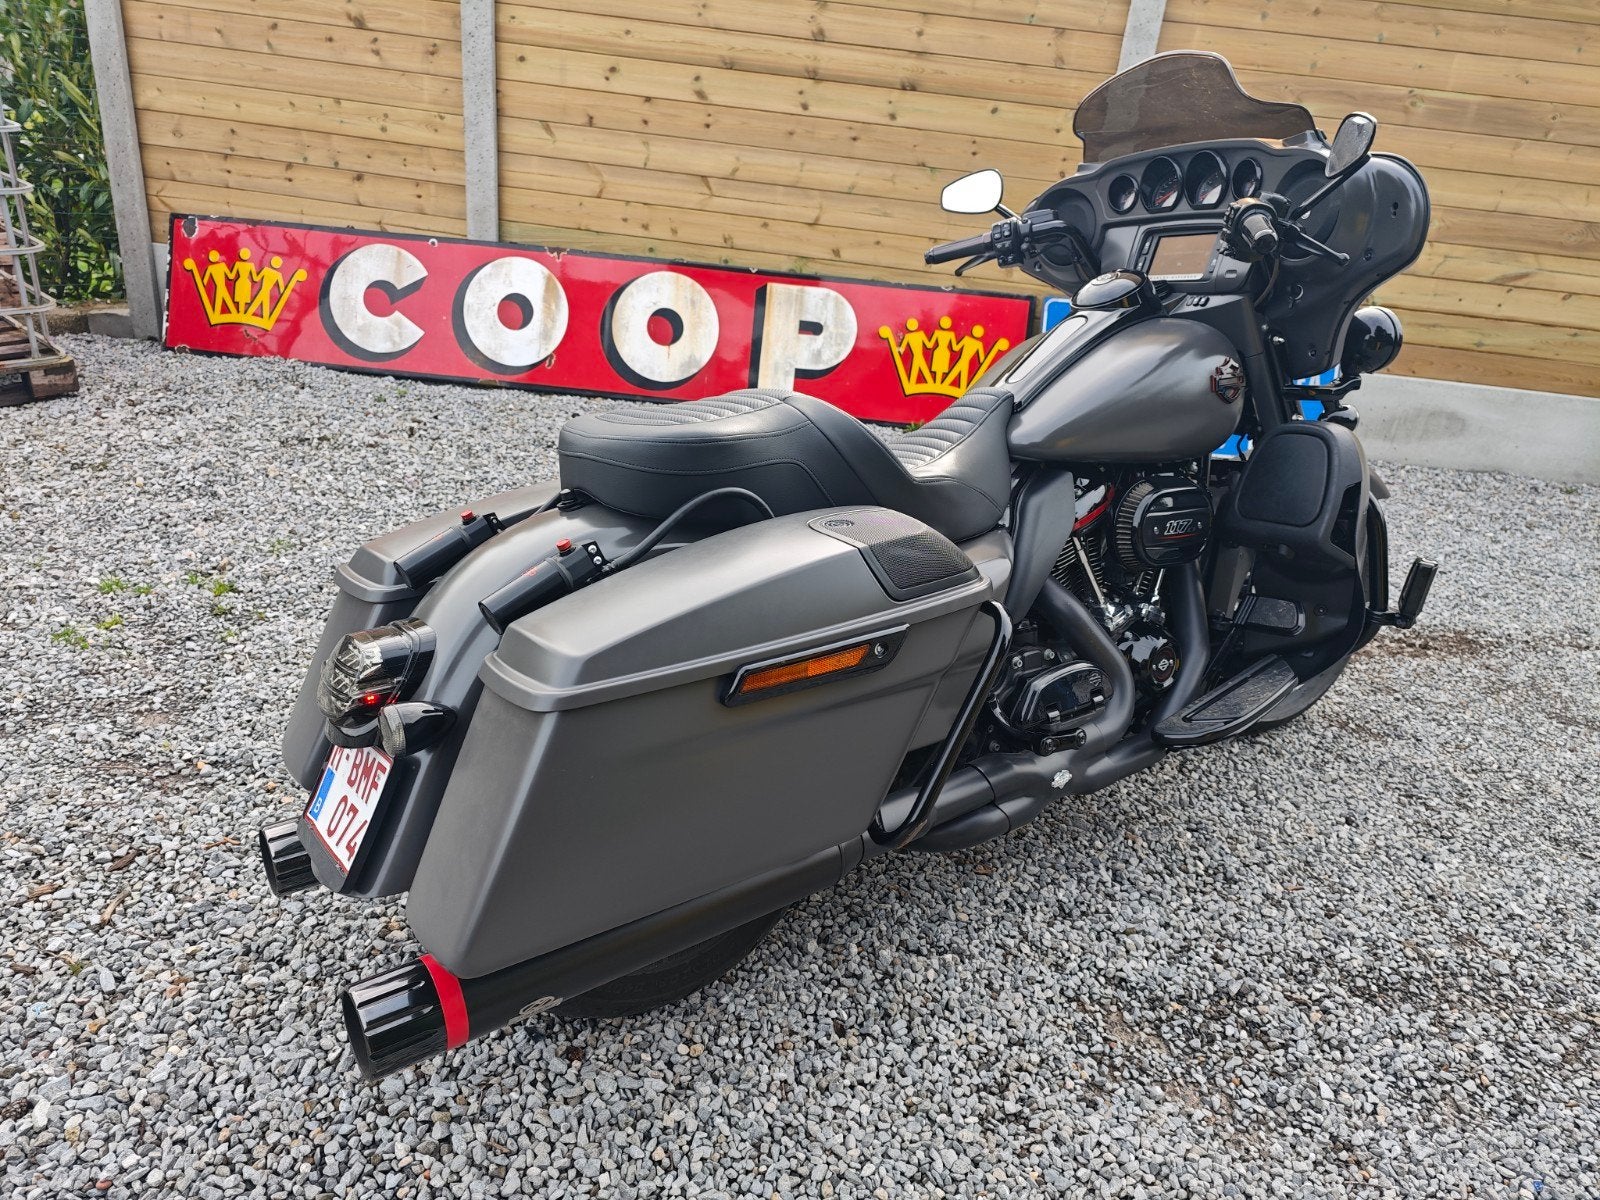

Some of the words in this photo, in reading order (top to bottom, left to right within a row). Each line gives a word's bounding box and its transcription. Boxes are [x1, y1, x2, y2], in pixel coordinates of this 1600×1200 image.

[319, 243, 859, 391] COOP
[1164, 518, 1194, 536] 117
[326, 794, 369, 863] 074
